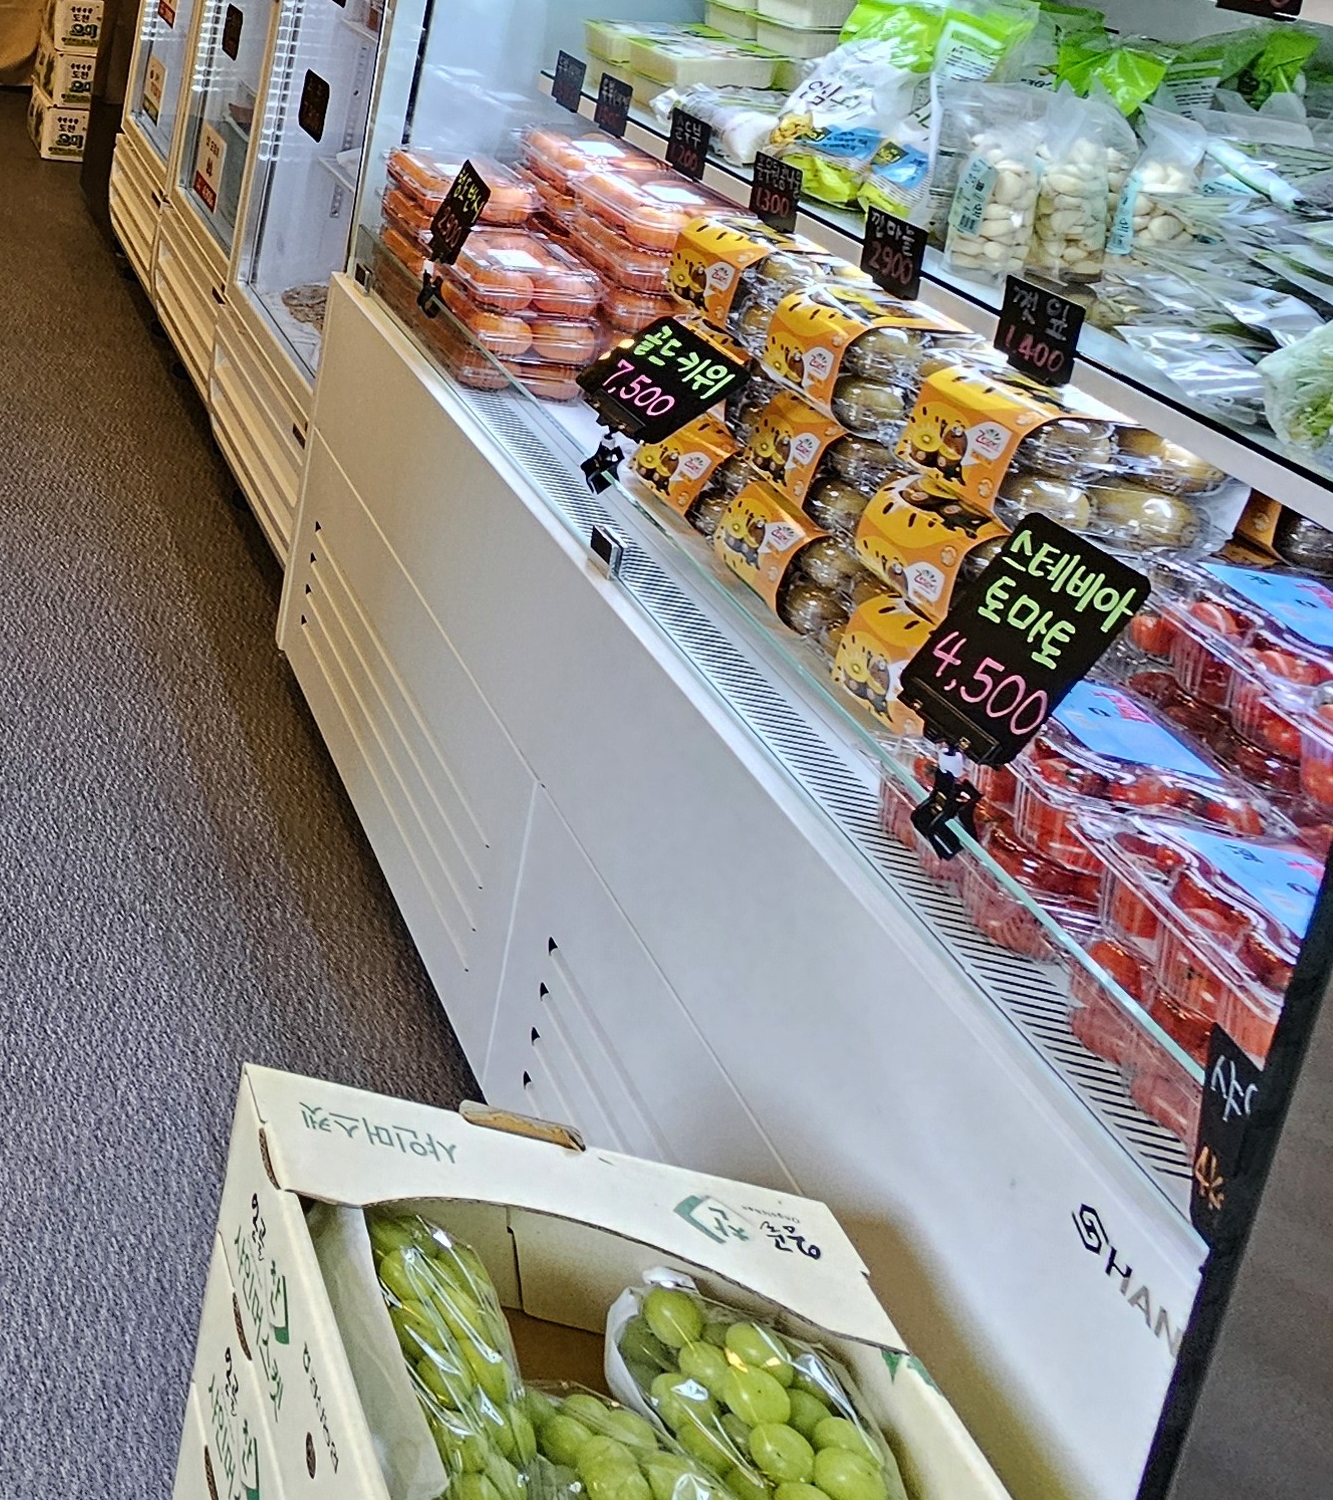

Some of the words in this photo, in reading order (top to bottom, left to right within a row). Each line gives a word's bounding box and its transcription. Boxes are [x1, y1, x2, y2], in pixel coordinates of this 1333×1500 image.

[633, 324, 736, 400] 골드키위
[977, 576, 1077, 671] 토마토
[1001, 529, 1136, 634] 스테비아
[932, 631, 1048, 736] 4,500
[300, 1101, 457, 1164] 샤인머스켓
